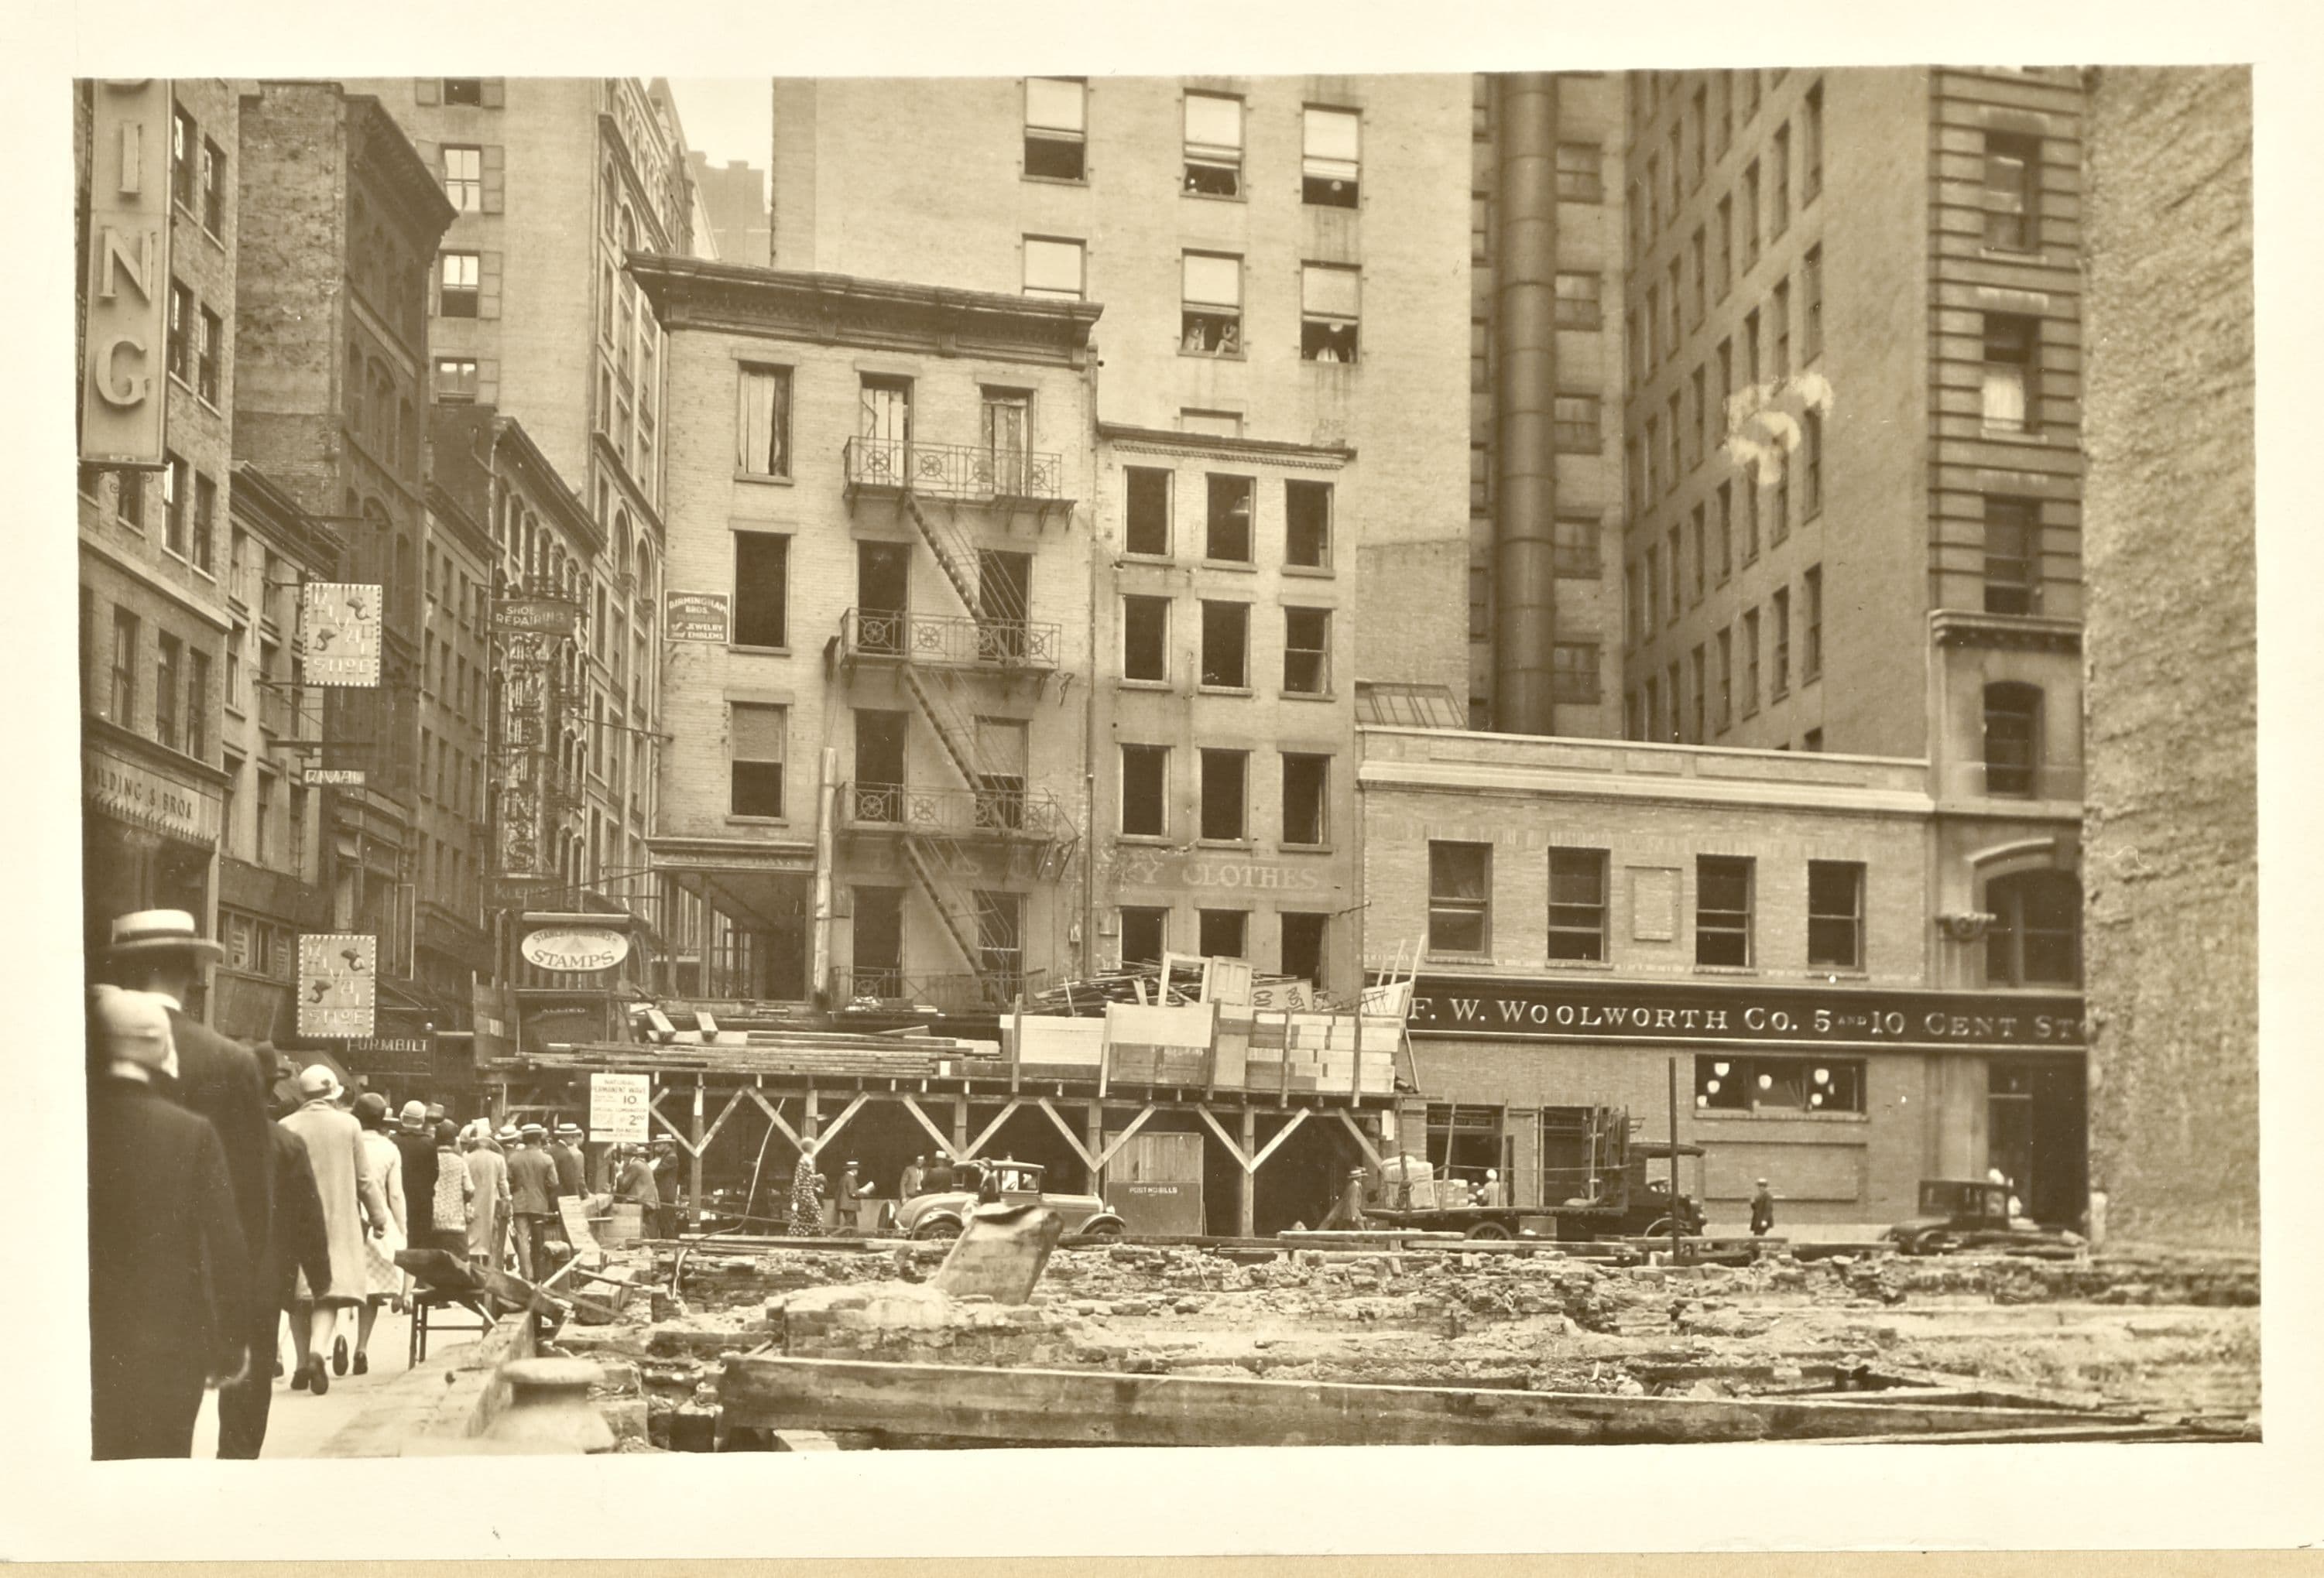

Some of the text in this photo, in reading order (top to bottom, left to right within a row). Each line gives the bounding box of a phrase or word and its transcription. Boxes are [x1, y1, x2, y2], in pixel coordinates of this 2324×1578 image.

[95, 77, 156, 406] ING
[506, 606, 535, 615] SHOE
[668, 596, 728, 614] BIRMINGHAM
[686, 622, 724, 632] JEWELRY
[313, 658, 370, 675] SHOE
[163, 792, 192, 819] BROS
[1181, 862, 1318, 890] CLOTHES
[531, 950, 615, 967] STAMPS
[309, 1009, 365, 1025] SHOE
[1408, 997, 1436, 1020] F.
[1449, 998, 1486, 1022] W.
[1496, 1000, 1728, 1029] WOOLWORTH
[1814, 1009, 1832, 1032] 5
[1870, 1011, 1906, 1035] 10
